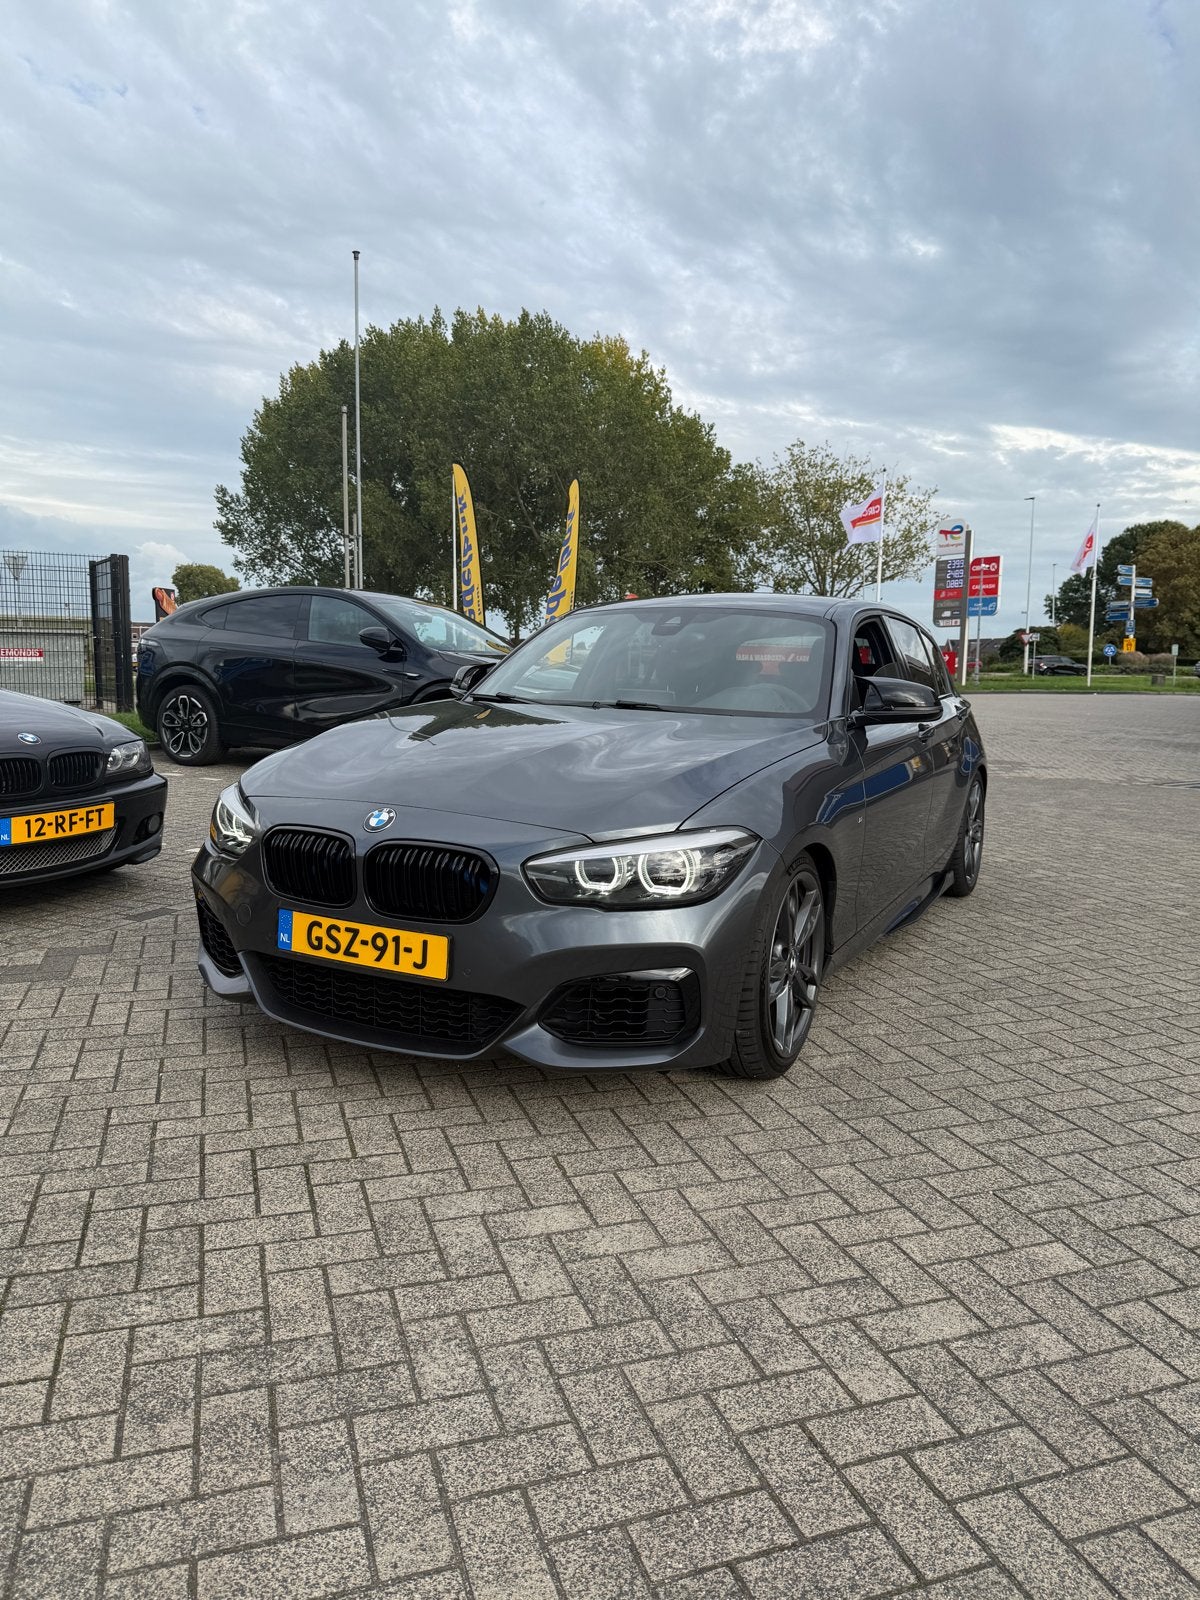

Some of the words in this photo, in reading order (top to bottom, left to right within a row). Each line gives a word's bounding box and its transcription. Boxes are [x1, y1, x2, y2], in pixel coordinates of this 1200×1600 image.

[0, 648, 40, 657] EMONDIS
[25, 808, 105, 838] 12-RF-FT
[280, 933, 290, 943] NL
[306, 920, 428, 969] GSZ-91-J
